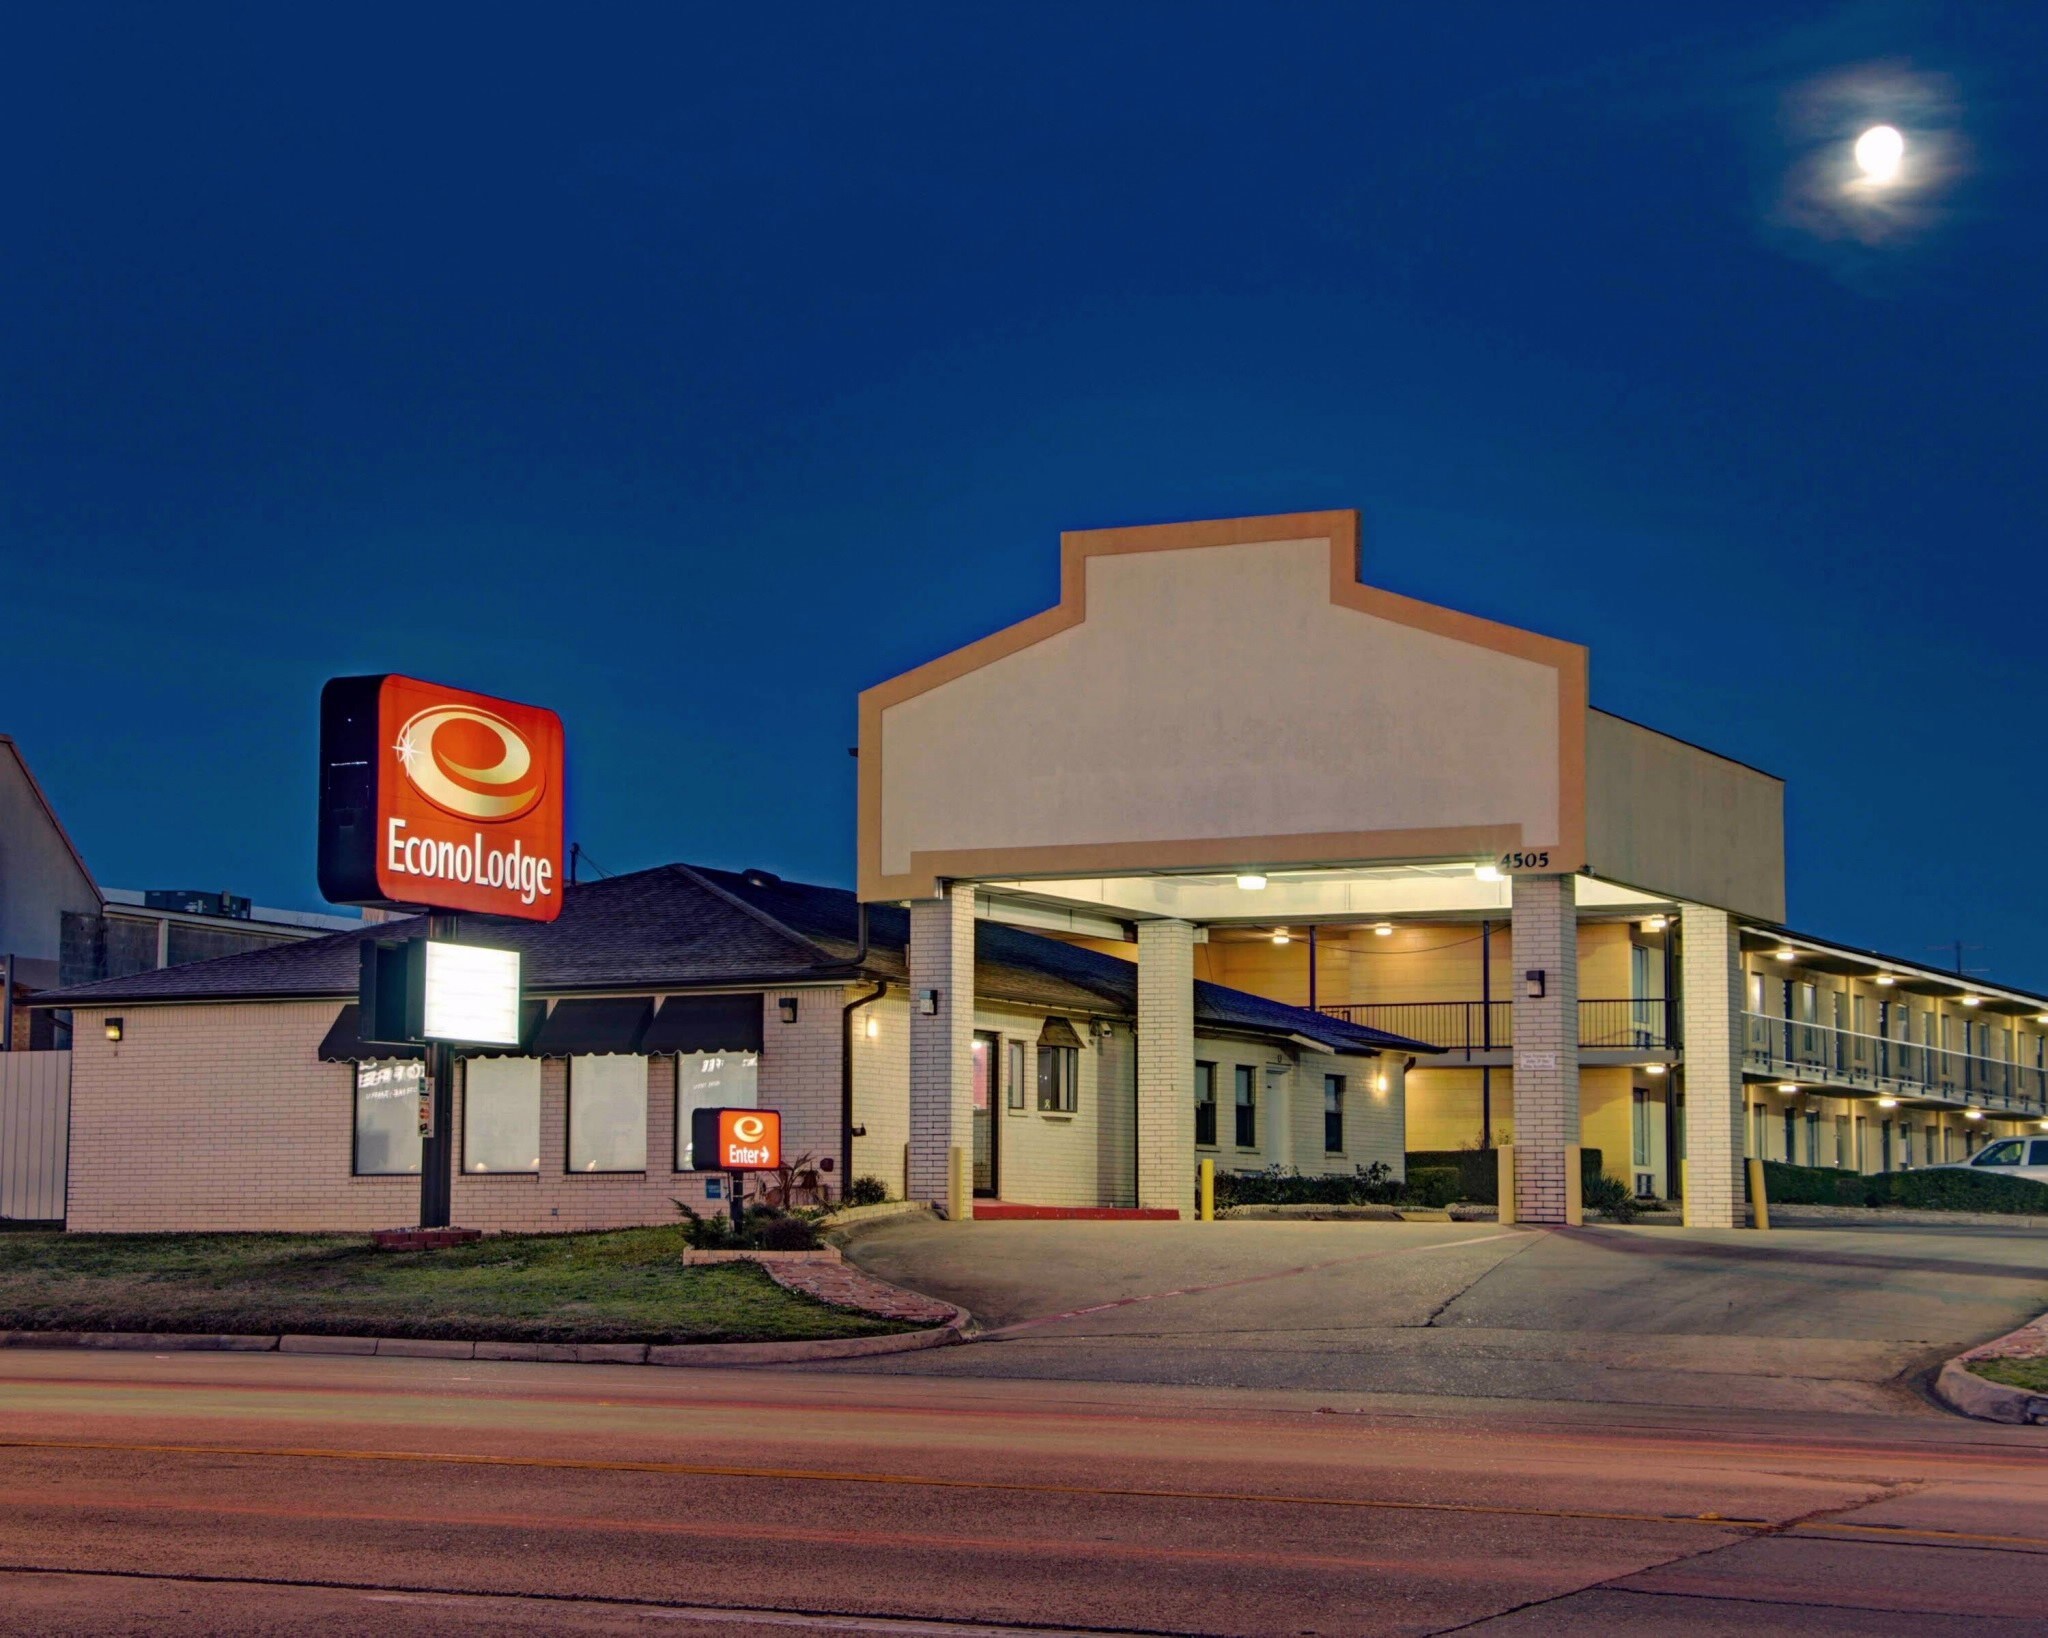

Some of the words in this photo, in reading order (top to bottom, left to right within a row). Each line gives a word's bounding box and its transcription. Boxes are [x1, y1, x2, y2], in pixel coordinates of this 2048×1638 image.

[388, 817, 552, 905] EconoLodge
[1501, 852, 1549, 868] 4505
[729, 1144, 760, 1164] Enter
